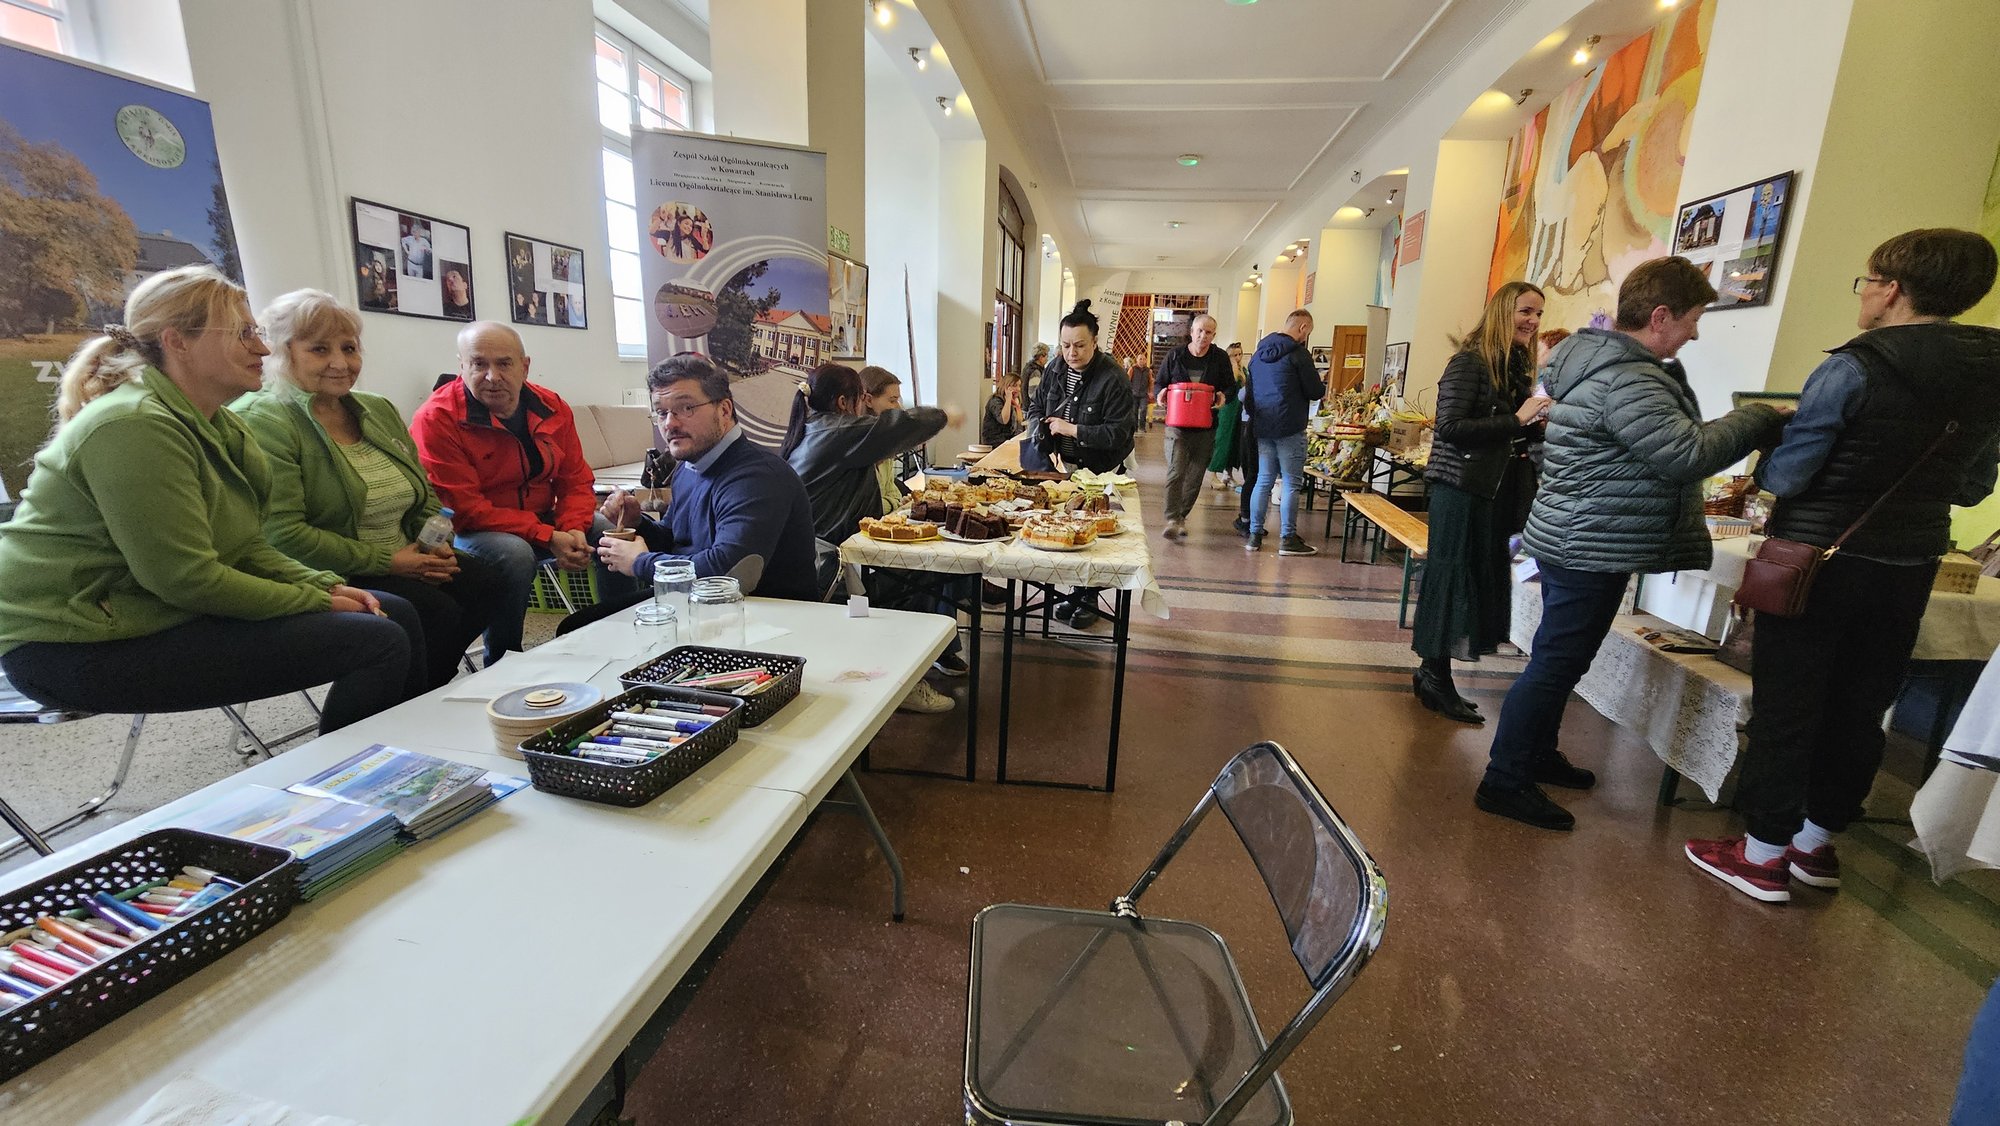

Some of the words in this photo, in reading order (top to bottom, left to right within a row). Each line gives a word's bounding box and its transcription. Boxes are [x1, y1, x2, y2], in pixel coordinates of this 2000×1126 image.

[719, 166, 755, 176] Kowarach
[650, 178, 678, 188] Liceum
[743, 188, 754, 196] im.
[794, 193, 813, 202] Lema
[1104, 297, 1121, 305] Kowa
